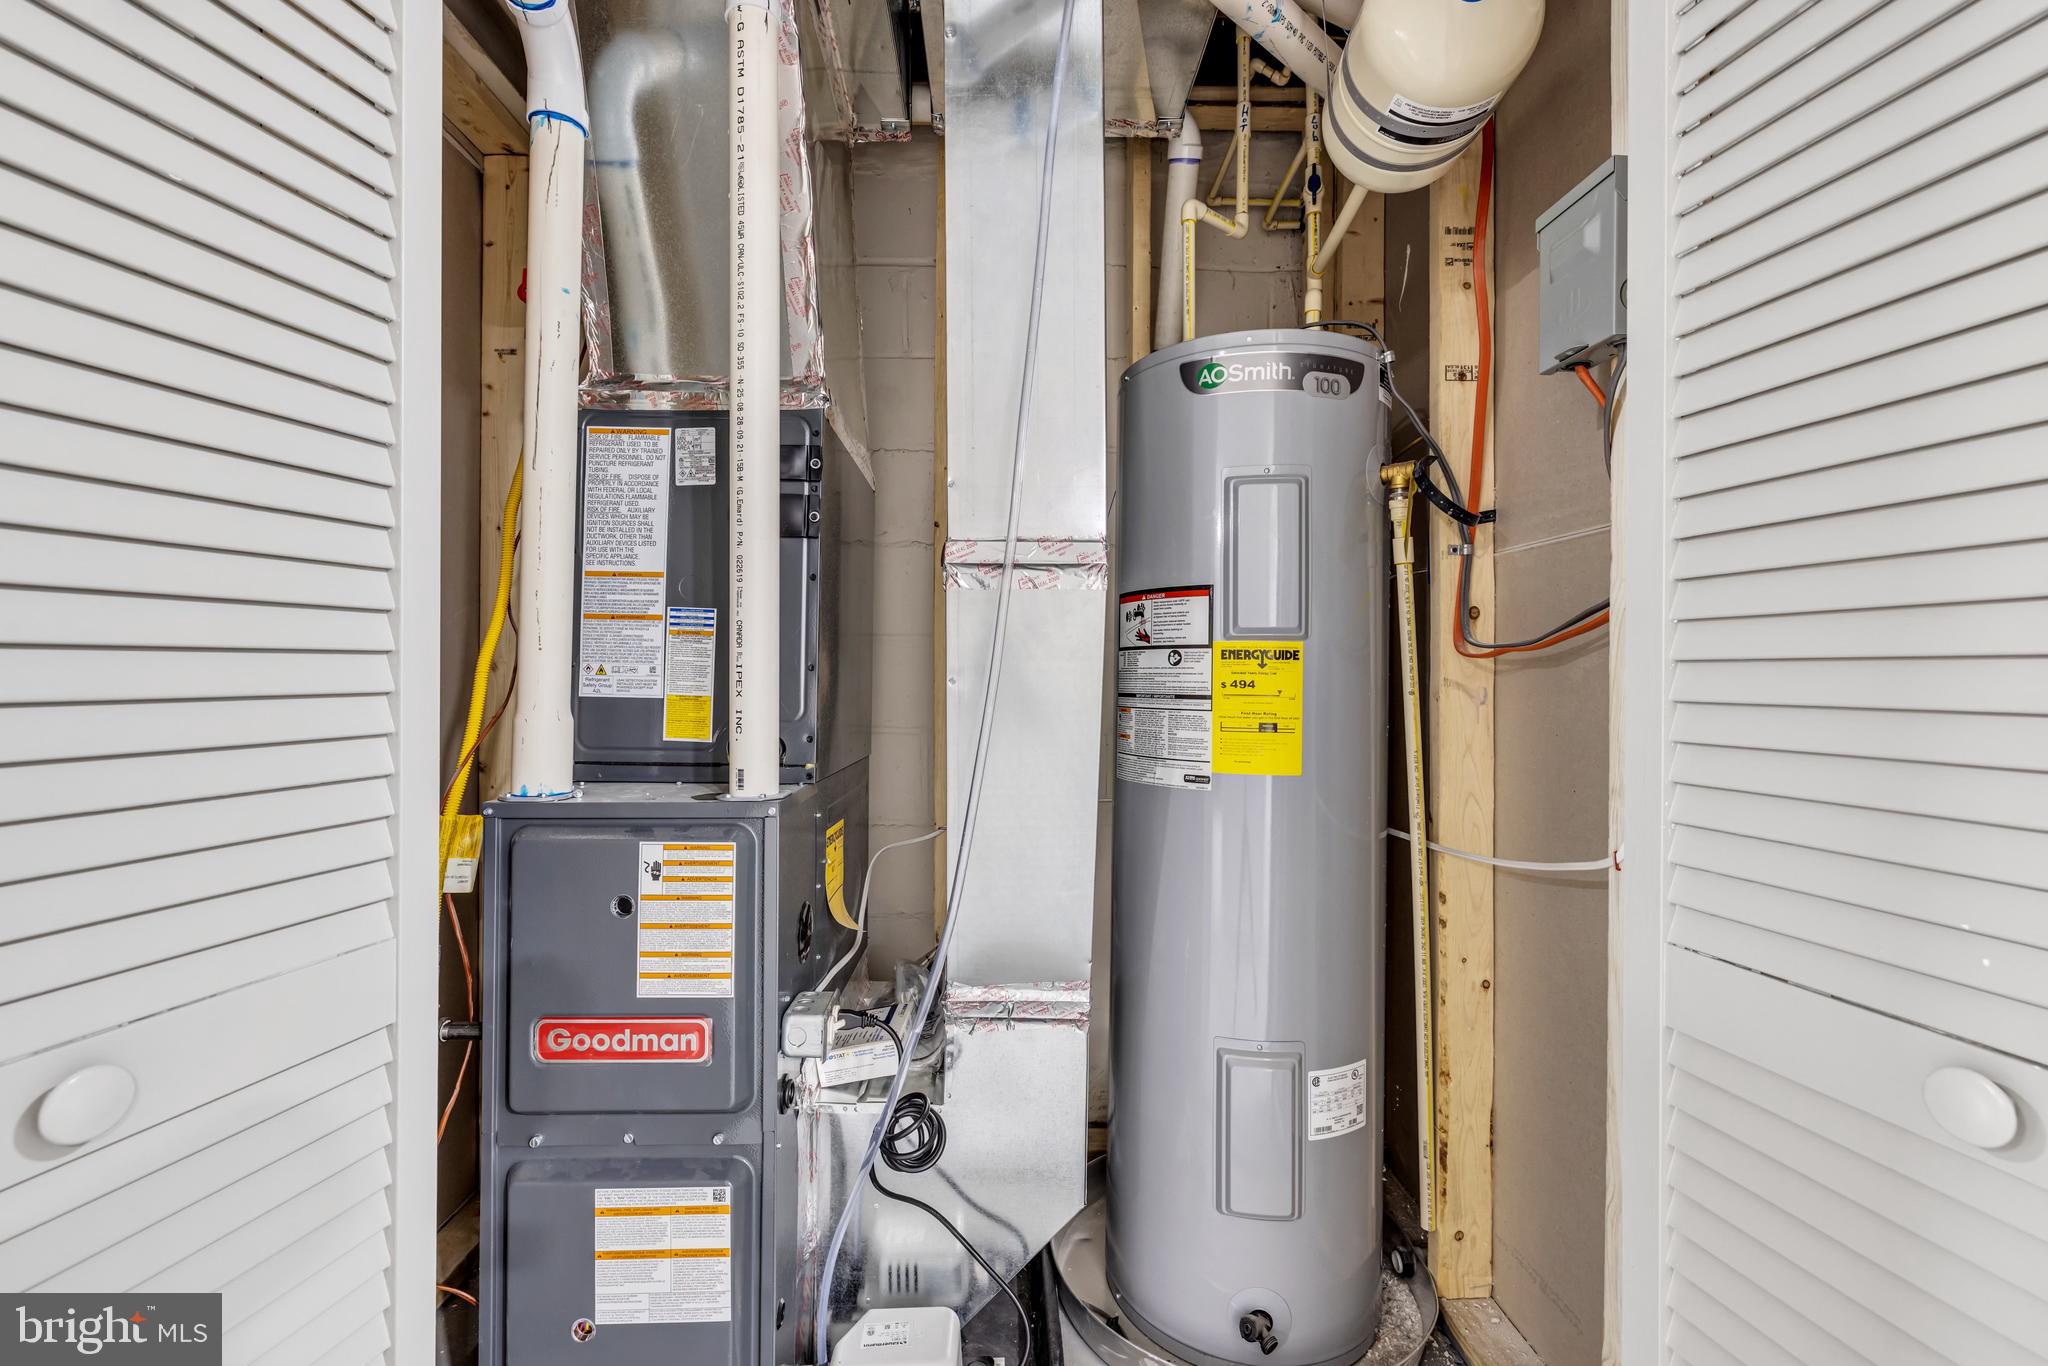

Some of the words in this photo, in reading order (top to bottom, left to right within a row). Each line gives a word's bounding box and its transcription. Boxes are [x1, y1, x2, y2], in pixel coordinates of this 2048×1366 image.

[736, 40, 744, 78] ASTM
[736, 87, 744, 160] D1785-21
[1314, 376, 1340, 396] 100
[736, 554, 744, 583] 022619
[1221, 649, 1300, 660] ENERGYGUIDE
[1230, 680, 1255, 688] 494
[547, 1028, 698, 1052] Goodman
